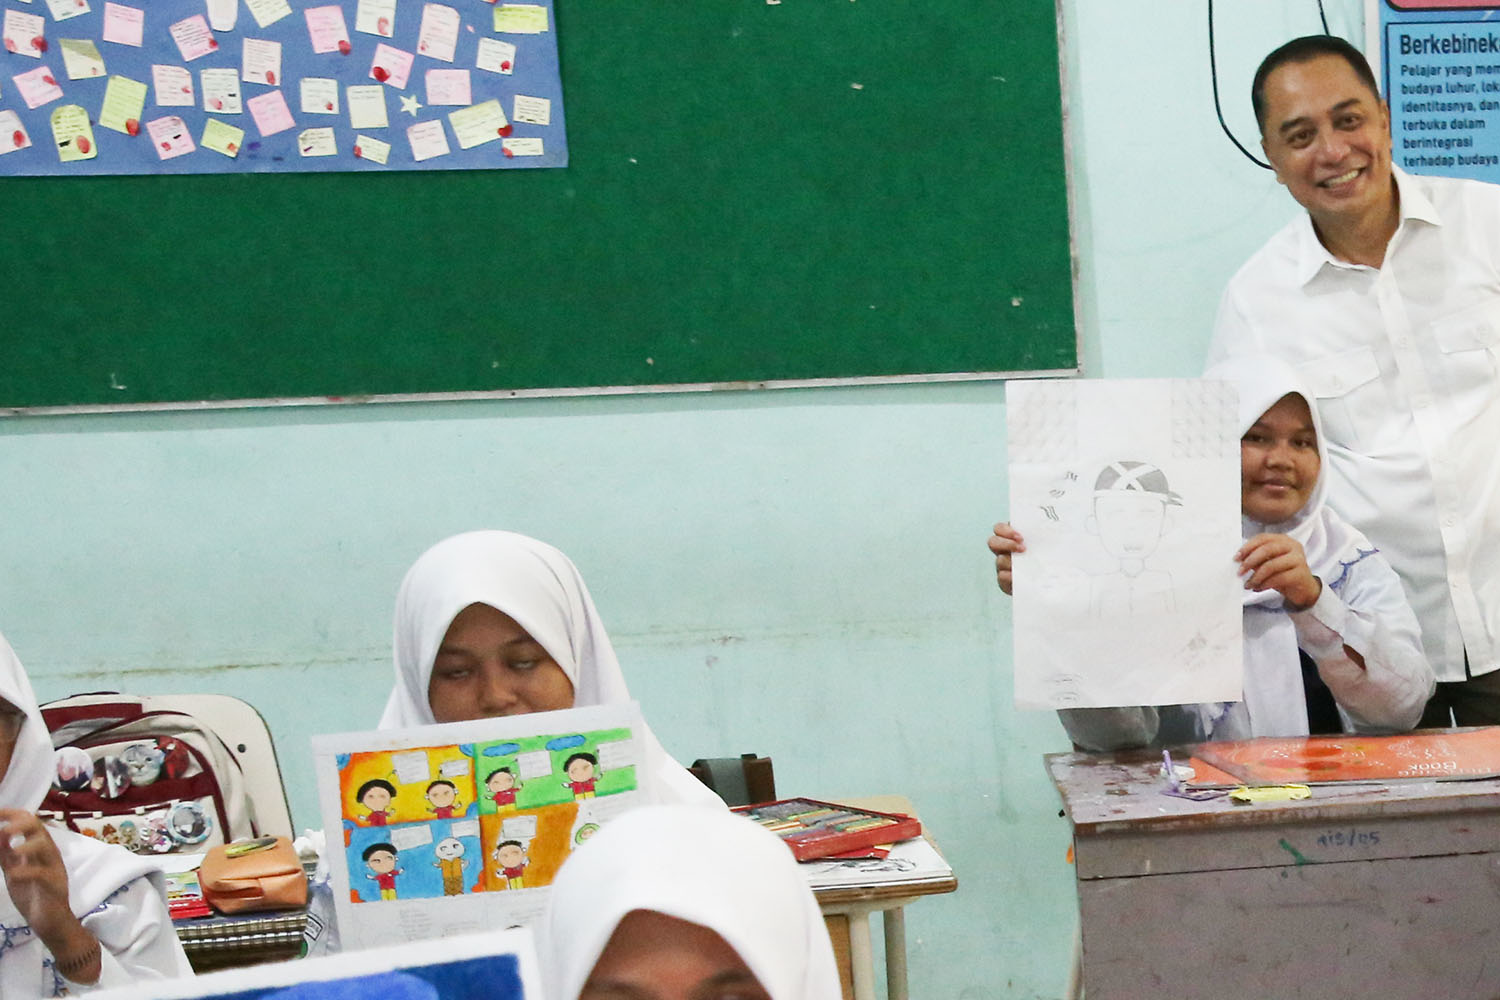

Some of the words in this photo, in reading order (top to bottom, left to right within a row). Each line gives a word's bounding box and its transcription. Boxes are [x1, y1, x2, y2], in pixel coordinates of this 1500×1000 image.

[1401, 64, 1442, 77] Pelajar
[1445, 66, 1472, 77] yang
[1401, 83, 1442, 95] budaya
[1446, 81, 1479, 94] luhur,
[1402, 101, 1476, 113] identitasnya,
[1480, 99, 1500, 111] dan
[1403, 119, 1447, 131] terbuka
[1450, 118, 1485, 130] dalam
[1403, 136, 1473, 150] berintegrasi
[1404, 155, 1455, 168] terhadap
[1458, 154, 1499, 167] budaya
